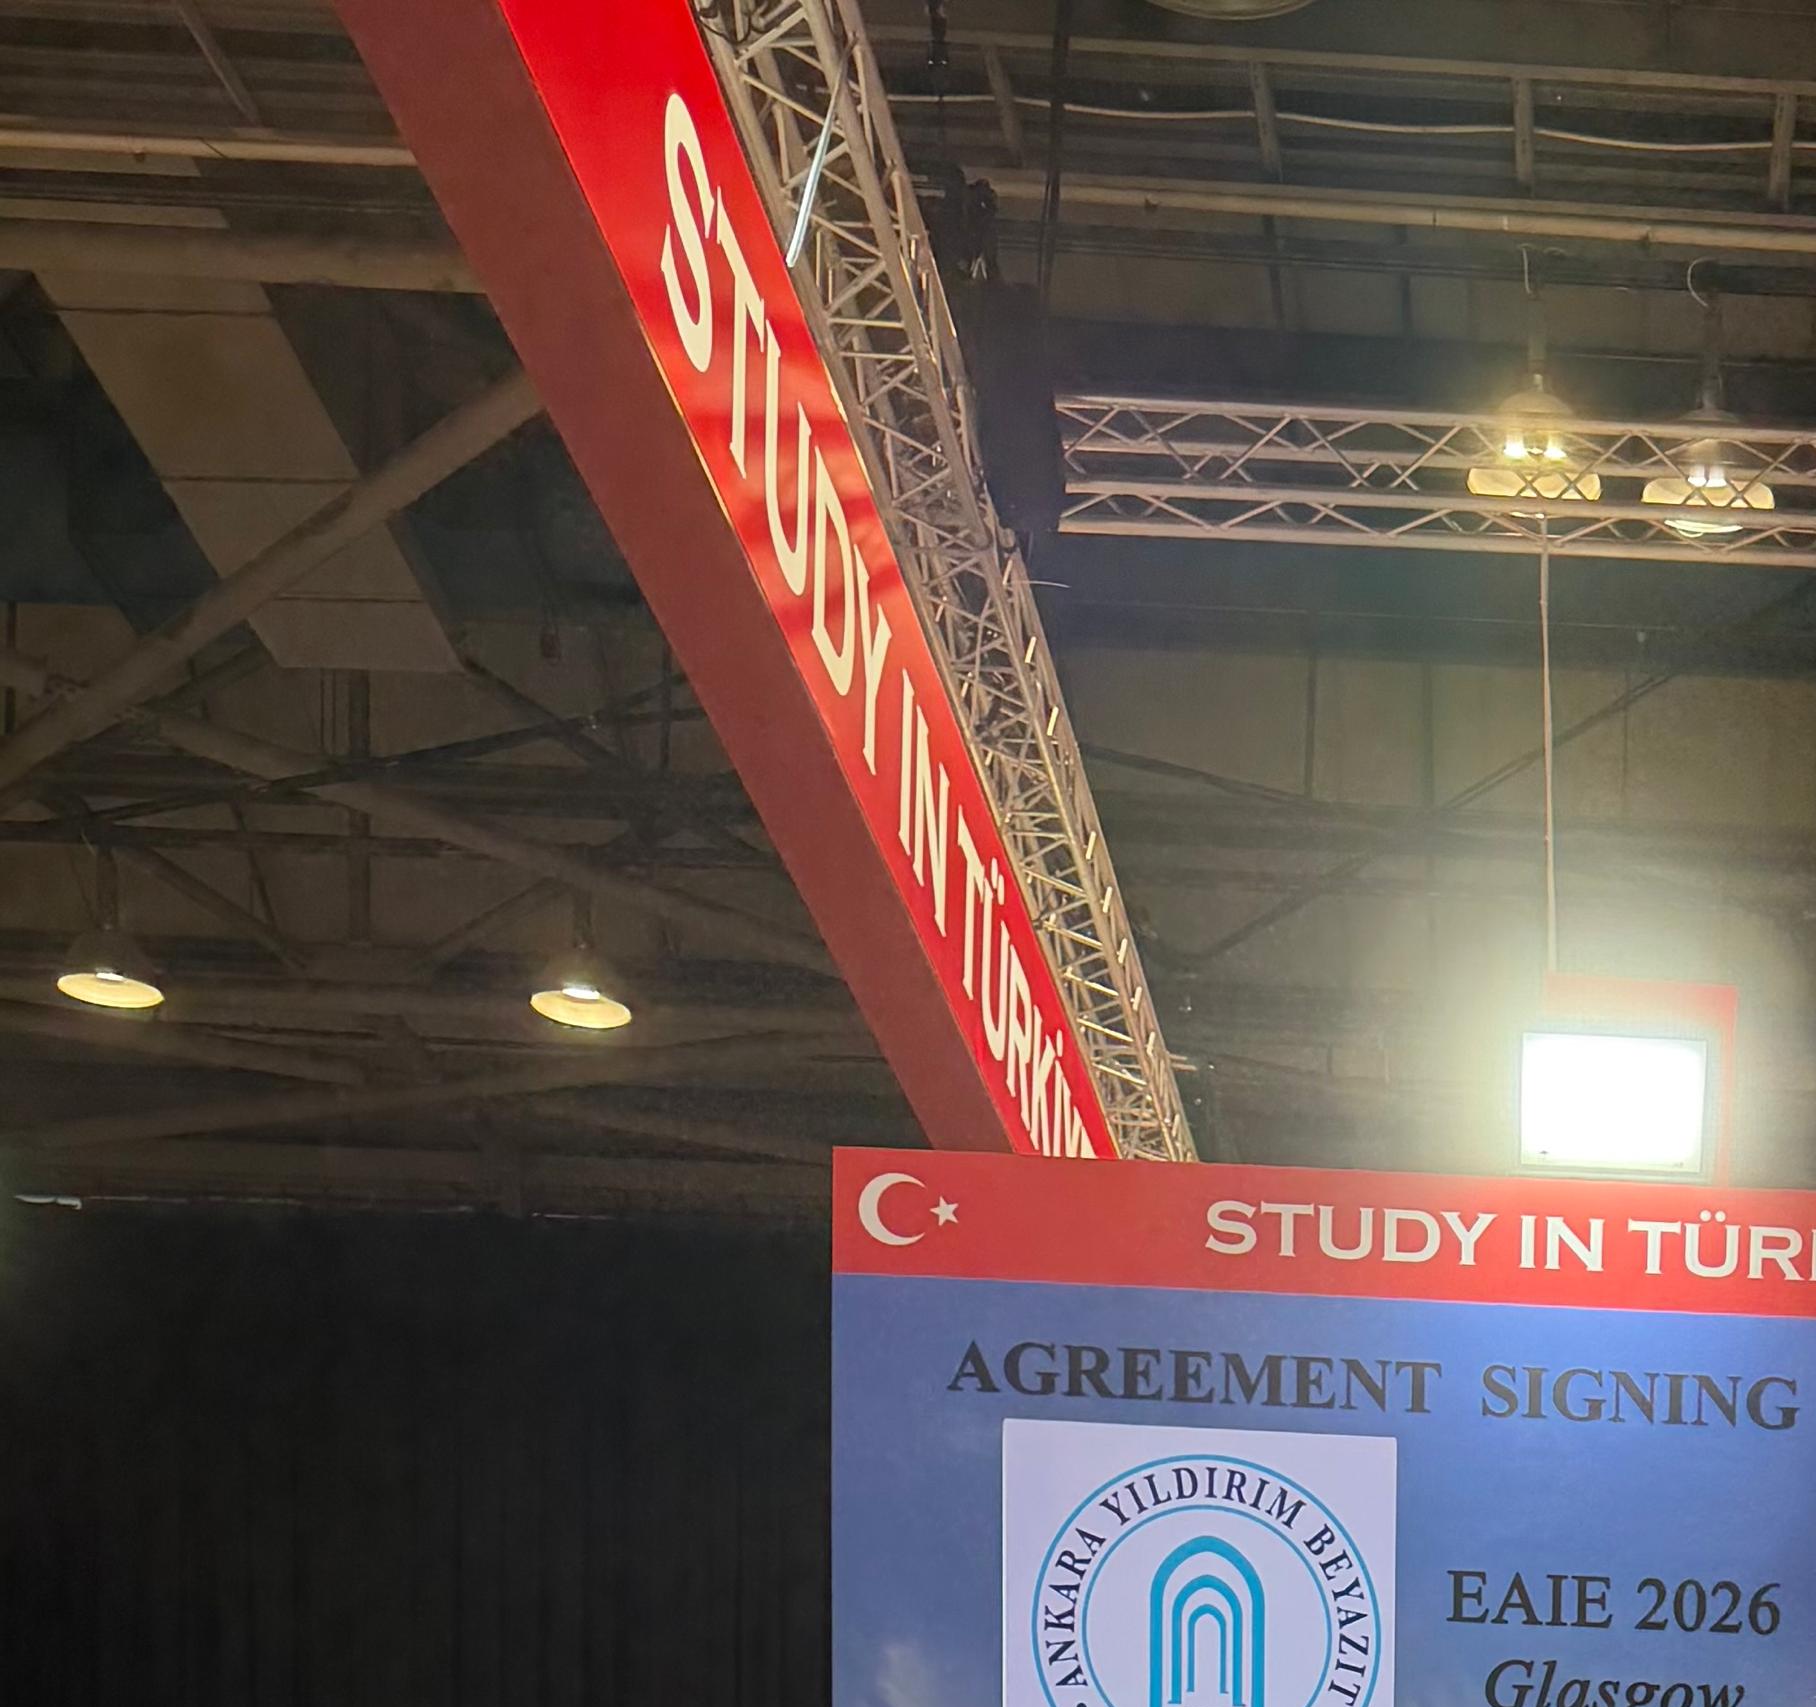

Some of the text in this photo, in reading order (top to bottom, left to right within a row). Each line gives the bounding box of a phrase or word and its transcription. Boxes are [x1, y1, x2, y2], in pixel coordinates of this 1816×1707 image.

[660, 91, 890, 775] STUDY
[898, 668, 950, 938] IN
[1205, 1200, 1498, 1266] STUDY
[1519, 1215, 1605, 1272] IN
[945, 1341, 1443, 1416] AGREEMENT
[1480, 1365, 1799, 1431] SIGNING
[1044, 1466, 1370, 1707] ANKARA YILDIRIM BEYAZIT
[1446, 1570, 1781, 1635] EAIE 2026
